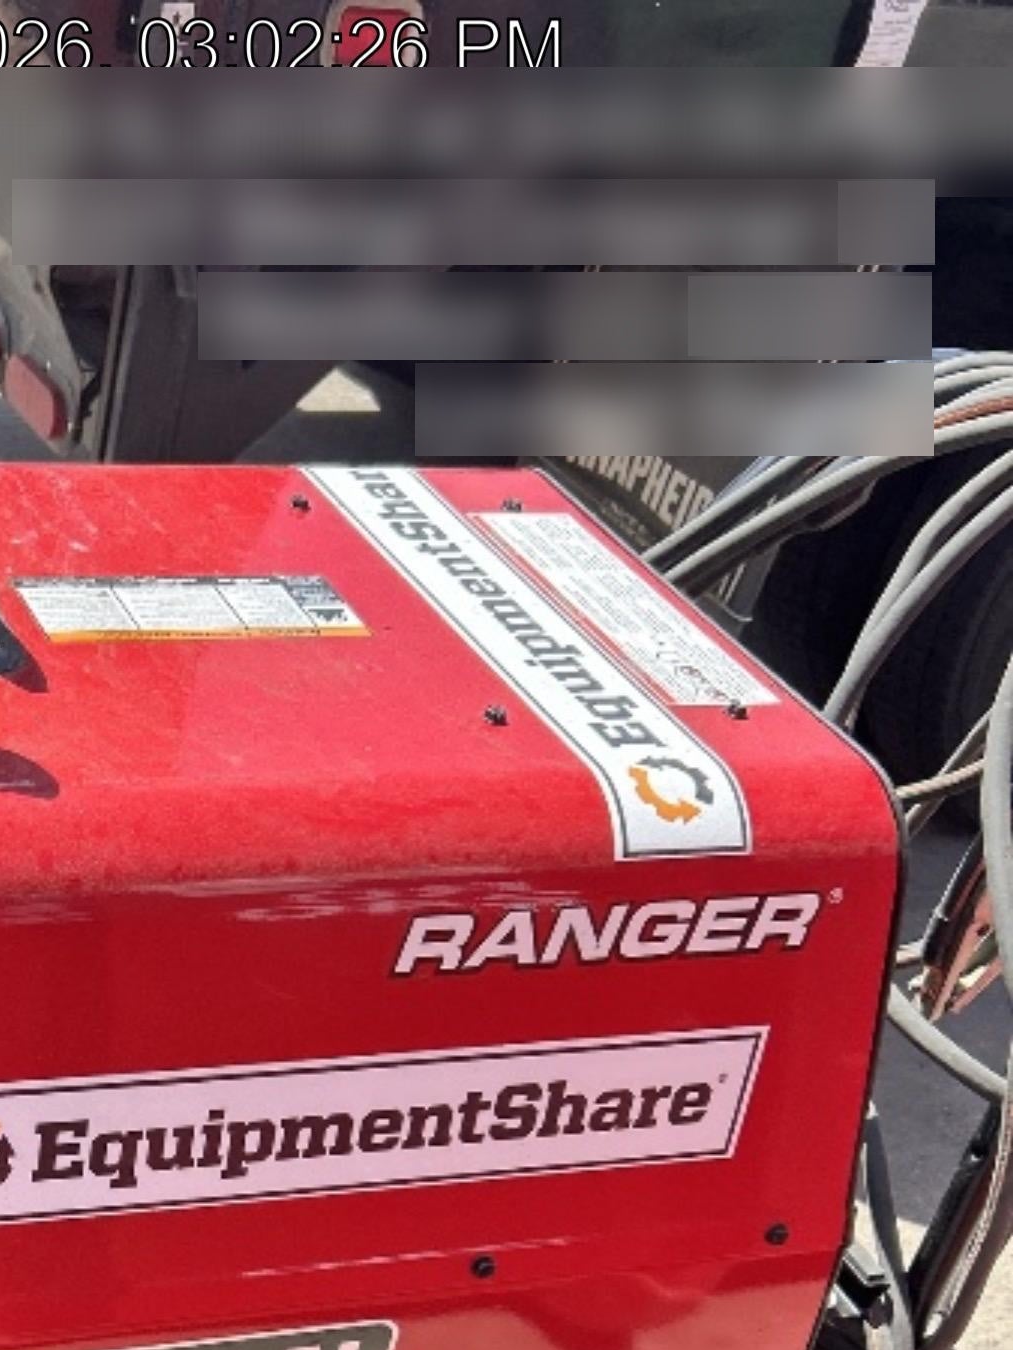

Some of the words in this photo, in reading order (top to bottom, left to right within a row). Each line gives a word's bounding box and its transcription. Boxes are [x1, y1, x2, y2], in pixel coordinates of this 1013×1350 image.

[348, 466, 668, 748] EquipmentShar
[393, 892, 820, 974] RANGER
[31, 1081, 714, 1188] EquipmentShare
